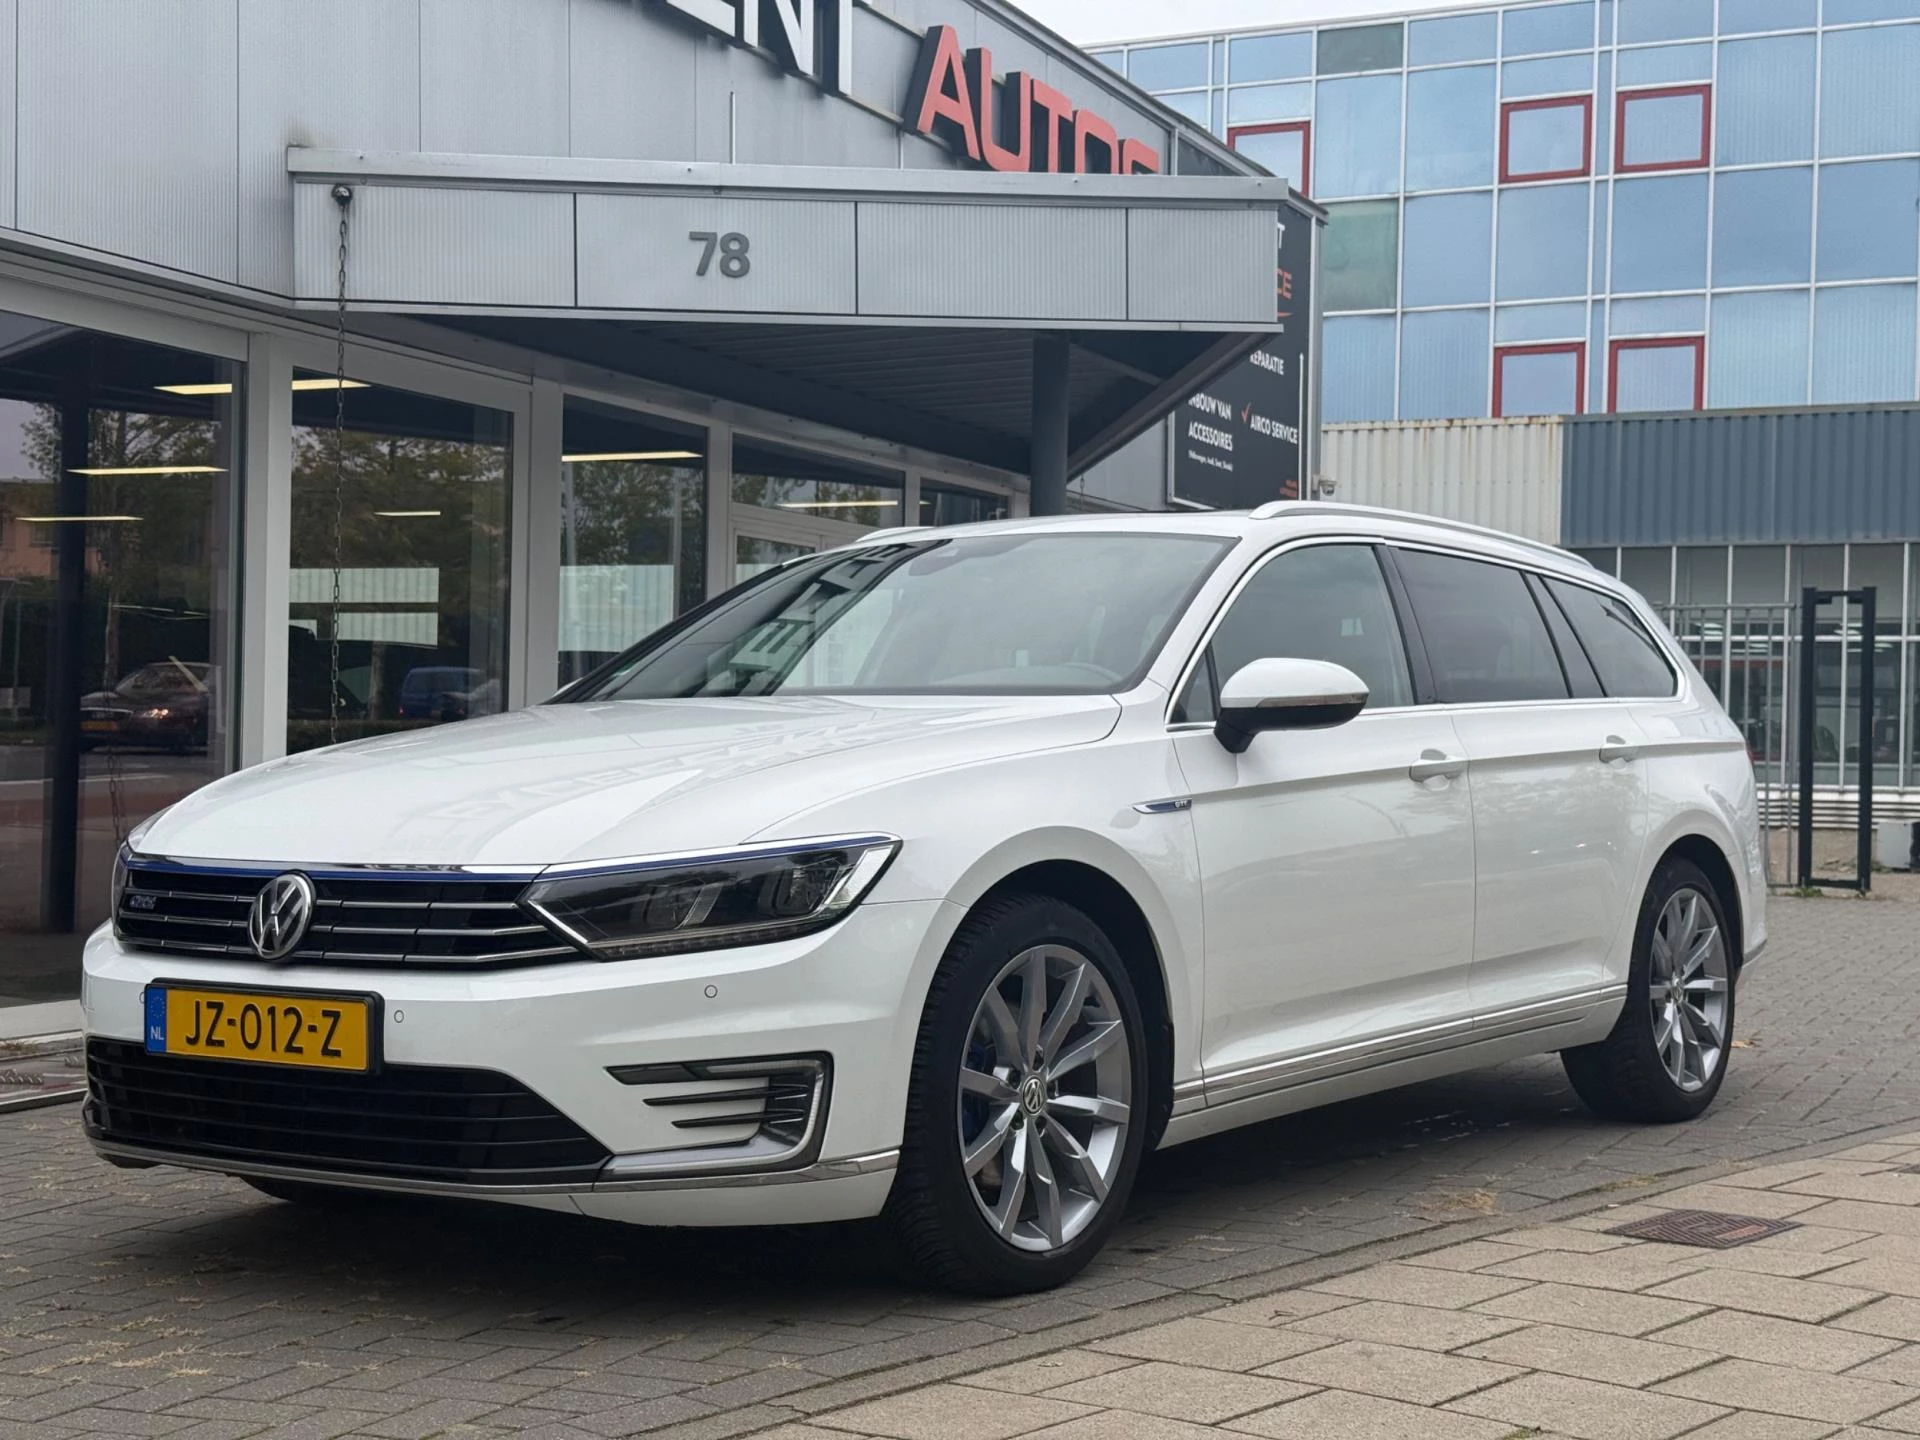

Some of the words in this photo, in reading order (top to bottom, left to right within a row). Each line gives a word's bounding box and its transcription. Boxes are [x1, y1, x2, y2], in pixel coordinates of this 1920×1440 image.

[688, 231, 751, 278] 78
[1217, 399, 1232, 421] VAN
[1187, 420, 1233, 452] ACCESSOIRES
[1250, 413, 1271, 436] AIRCO
[1271, 420, 1298, 445] SERVICE
[150, 1026, 164, 1042] NL
[185, 1000, 342, 1058] JZ-012-Z
